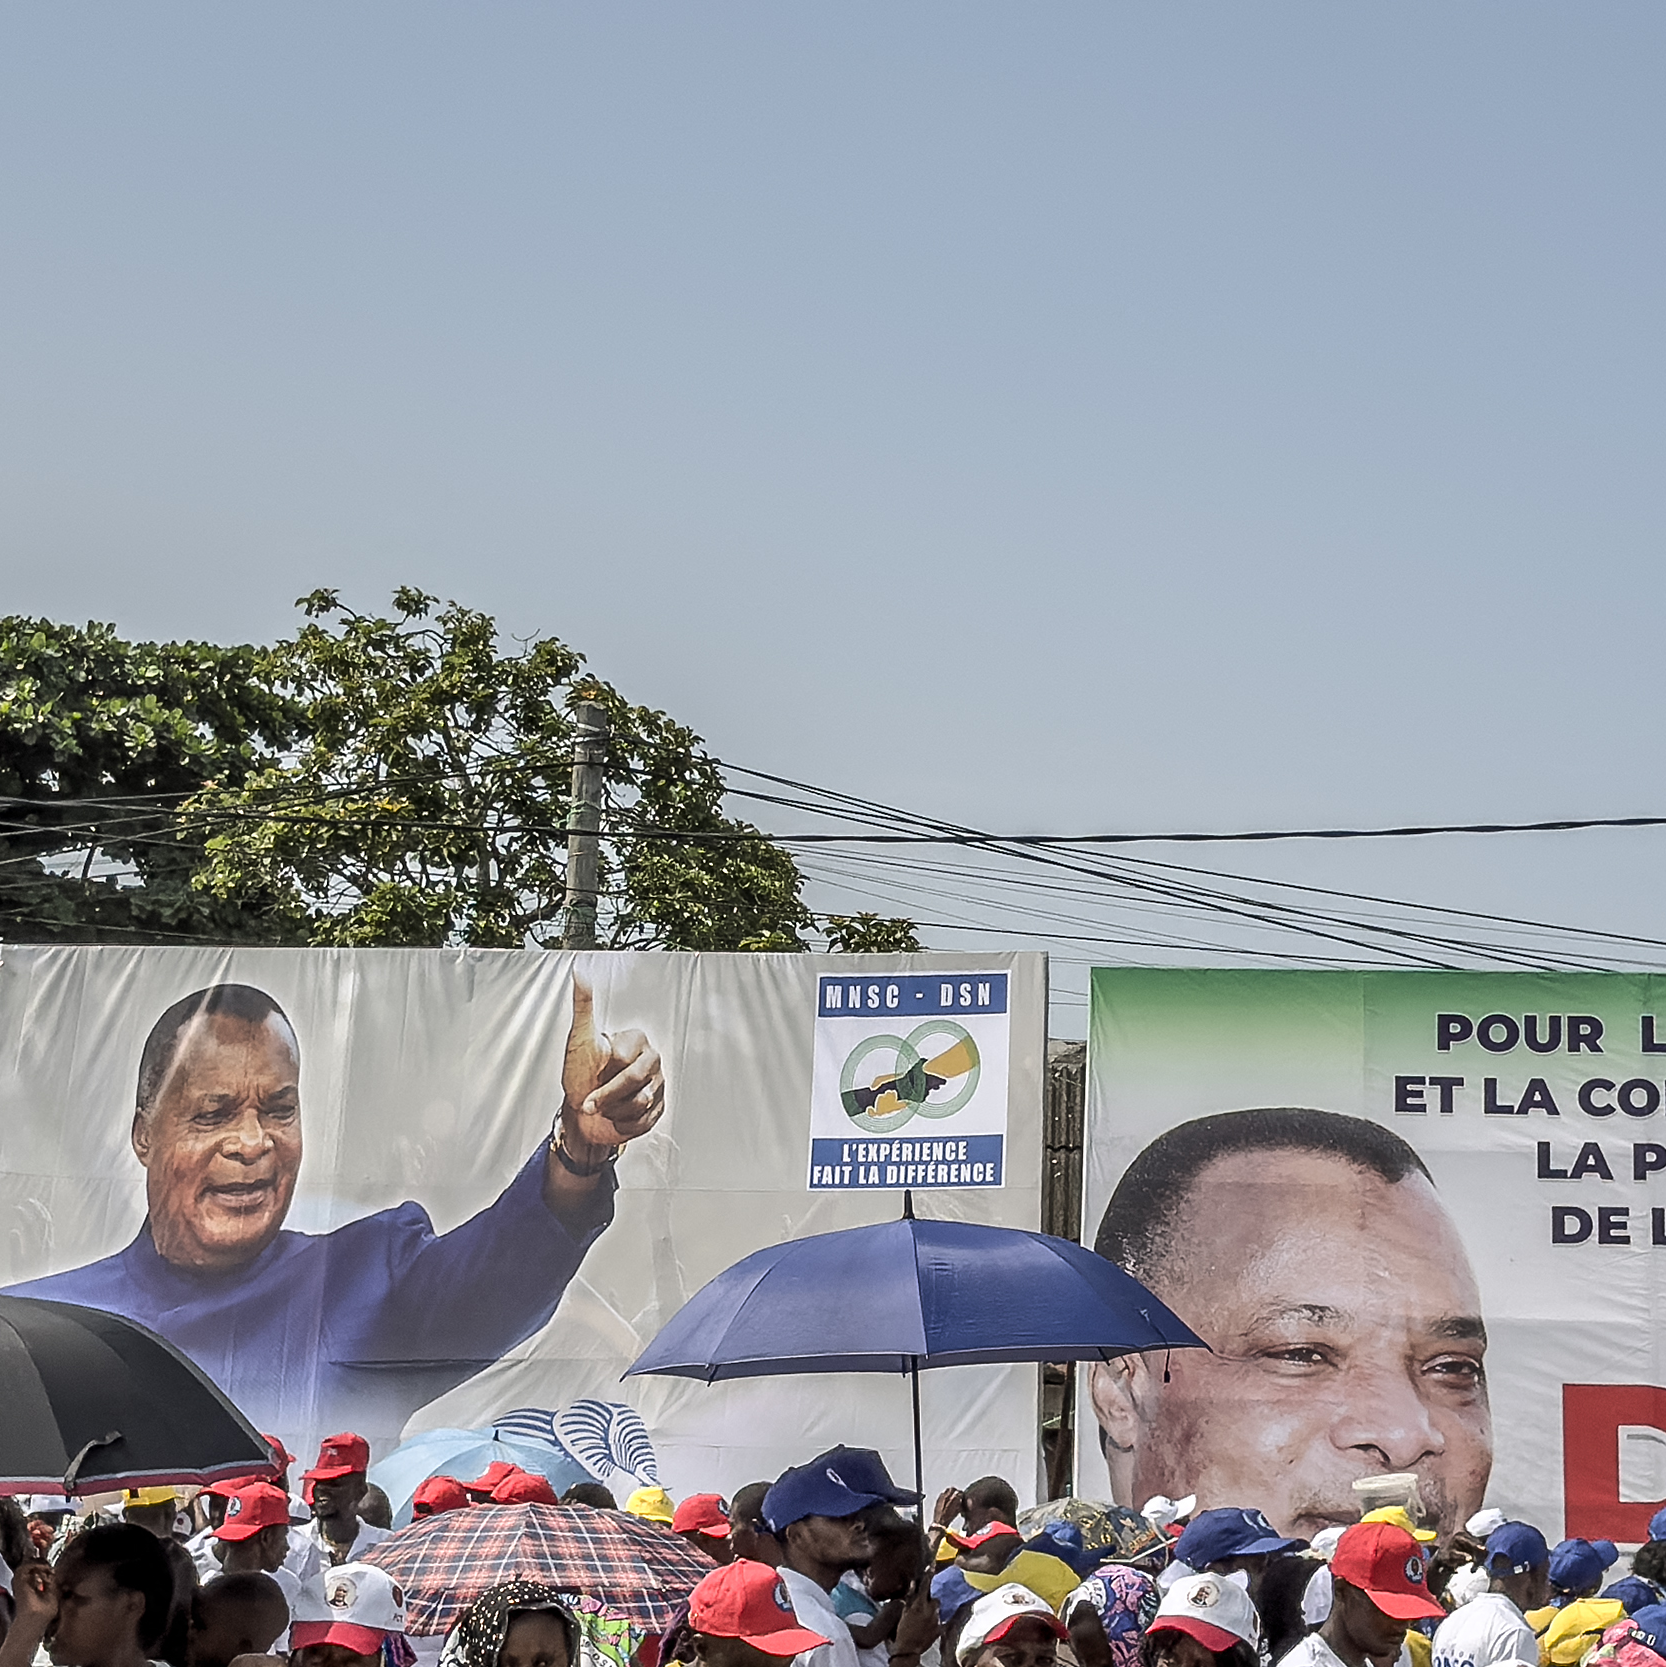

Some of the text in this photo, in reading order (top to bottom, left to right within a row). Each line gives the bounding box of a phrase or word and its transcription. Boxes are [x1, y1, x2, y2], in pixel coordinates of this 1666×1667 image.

[825, 984, 900, 1009] MNSC
[940, 982, 991, 1007] DSN
[1436, 1012, 1604, 1054] POUR
[1393, 1075, 1464, 1114] ET
[1483, 1077, 1559, 1116] LA
[842, 1140, 968, 1163] L'EXPÉRIENCE
[1536, 1140, 1614, 1180] LA
[813, 1162, 995, 1185] FAIT LA DIFFÉRENCE
[1552, 1206, 1631, 1246] DE
